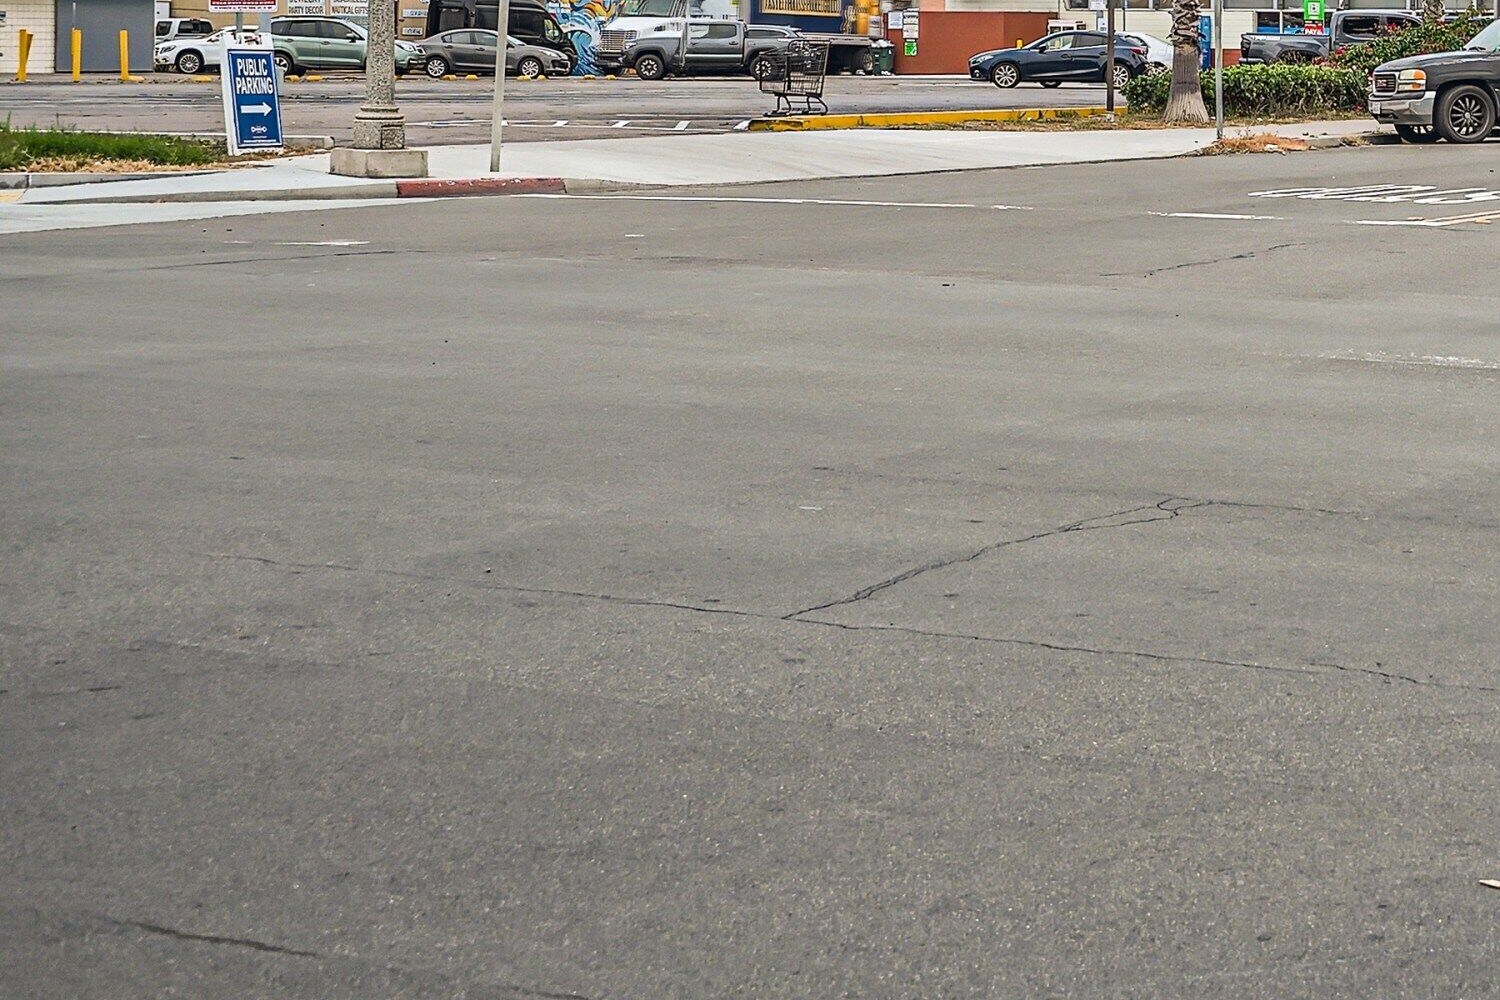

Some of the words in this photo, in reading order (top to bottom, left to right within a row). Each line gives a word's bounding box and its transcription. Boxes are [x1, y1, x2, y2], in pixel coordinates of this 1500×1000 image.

[289, 6, 304, 14] PARTY
[305, 6, 324, 14] DECOR
[237, 58, 268, 76] PUBLIC
[236, 77, 274, 94] PARKING
